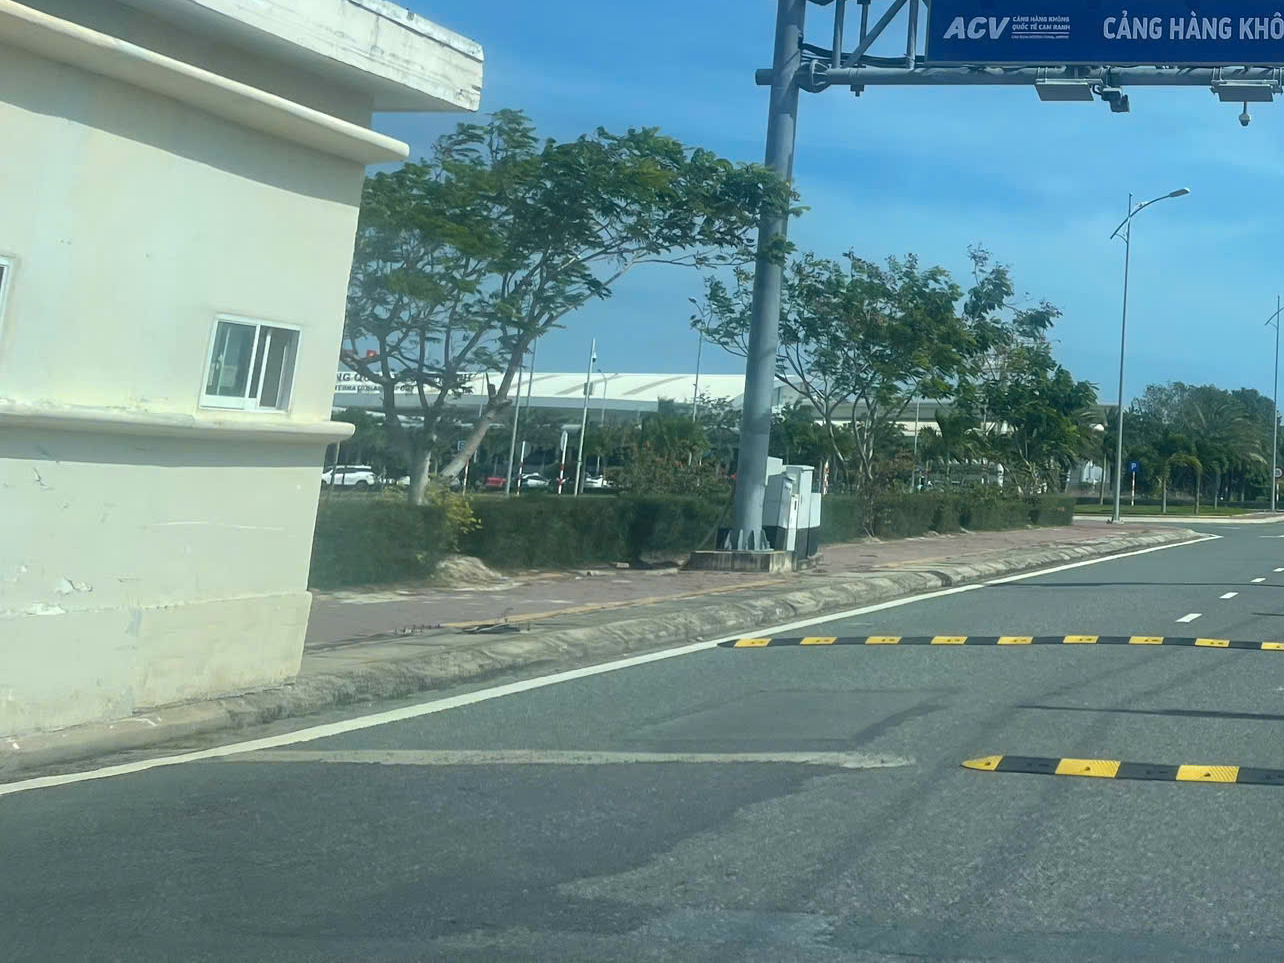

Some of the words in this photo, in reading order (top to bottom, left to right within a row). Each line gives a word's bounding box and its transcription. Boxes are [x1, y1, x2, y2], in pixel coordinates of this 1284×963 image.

[943, 16, 1010, 39] ACV
[1103, 10, 1163, 40] CẢNG
[1169, 10, 1232, 40] HÀNG
